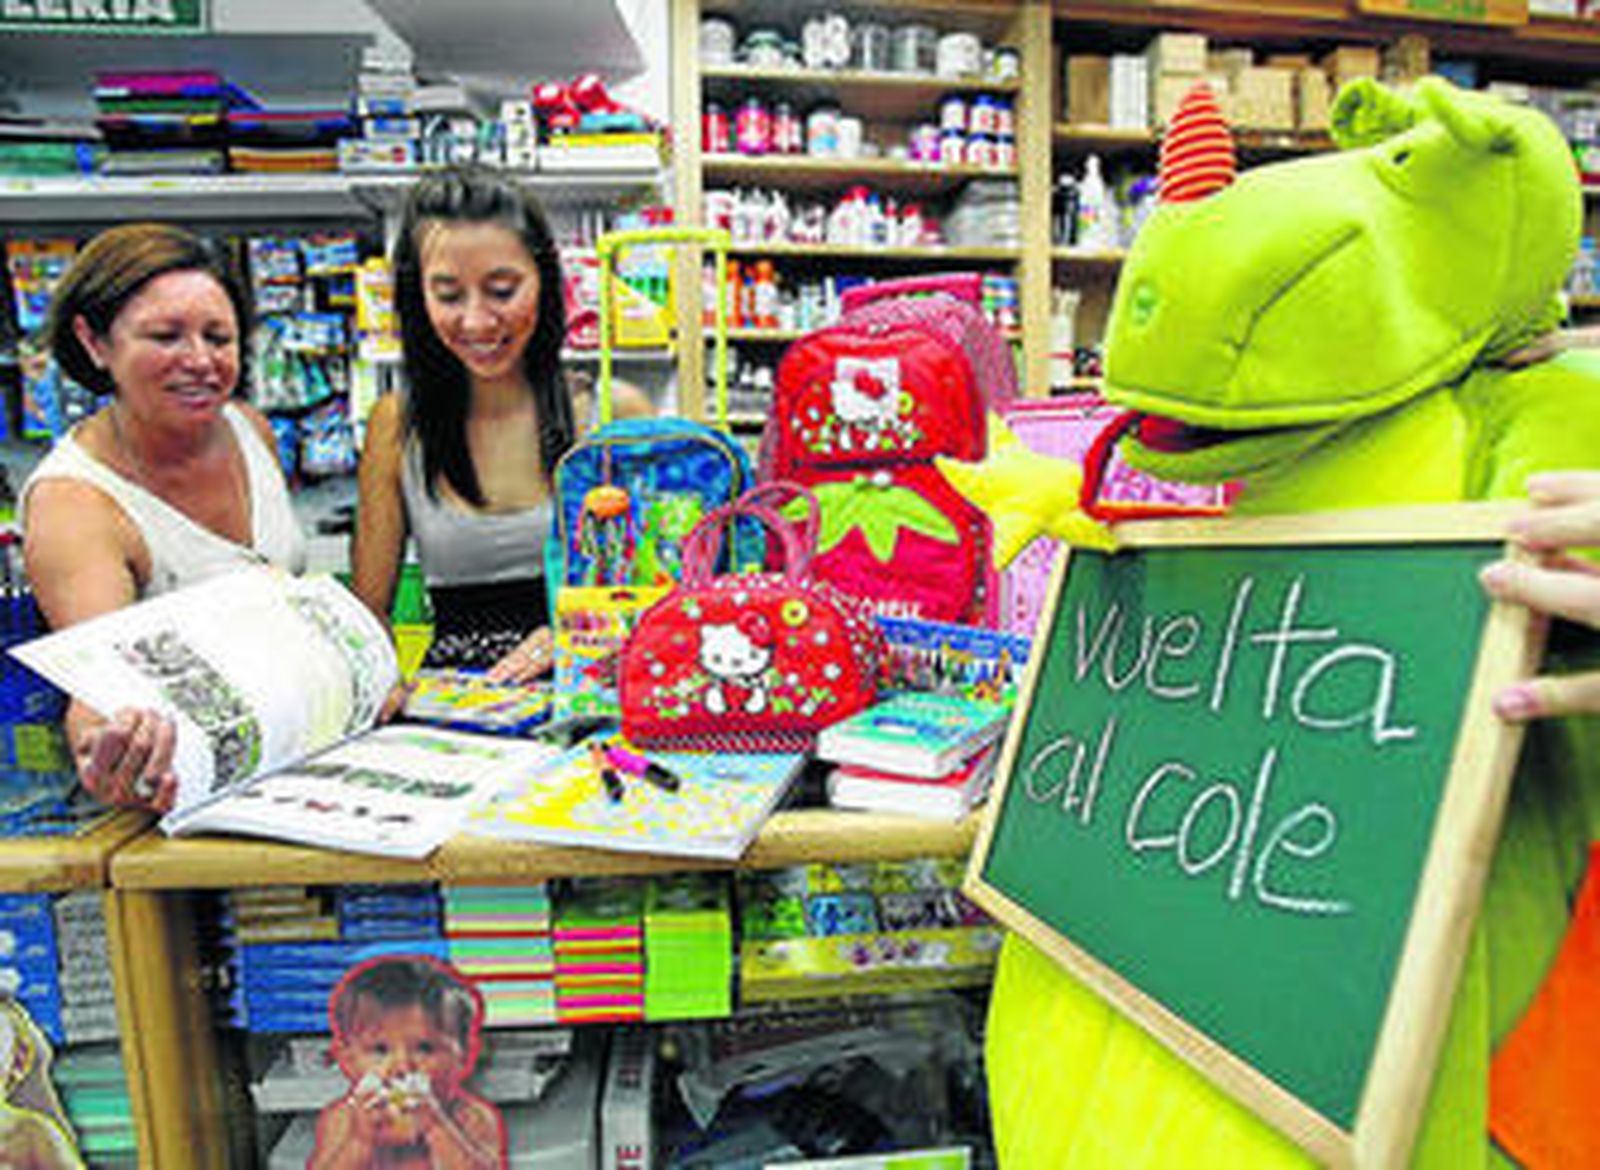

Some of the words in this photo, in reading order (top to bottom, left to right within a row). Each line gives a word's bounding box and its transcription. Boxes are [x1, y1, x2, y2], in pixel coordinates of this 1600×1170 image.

[1074, 574, 1416, 744] vuelta
[1024, 718, 1115, 825] al
[1126, 748, 1352, 914] cole
